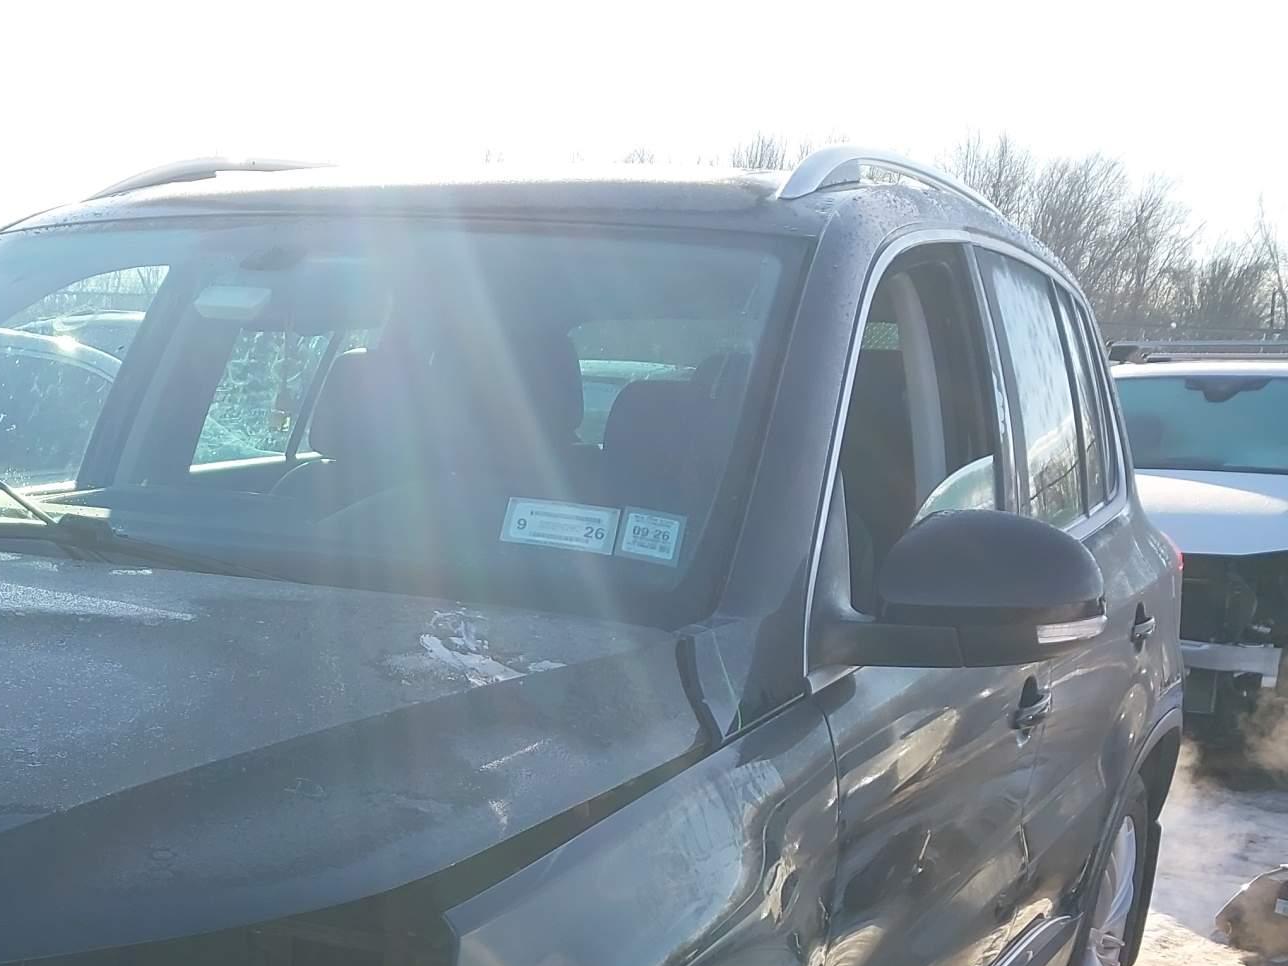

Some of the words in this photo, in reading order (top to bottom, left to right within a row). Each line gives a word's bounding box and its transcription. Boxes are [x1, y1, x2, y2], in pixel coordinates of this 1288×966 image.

[516, 518, 527, 530] 9
[583, 526, 605, 540] 26
[632, 525, 649, 537] 09
[653, 529, 670, 541] 26
